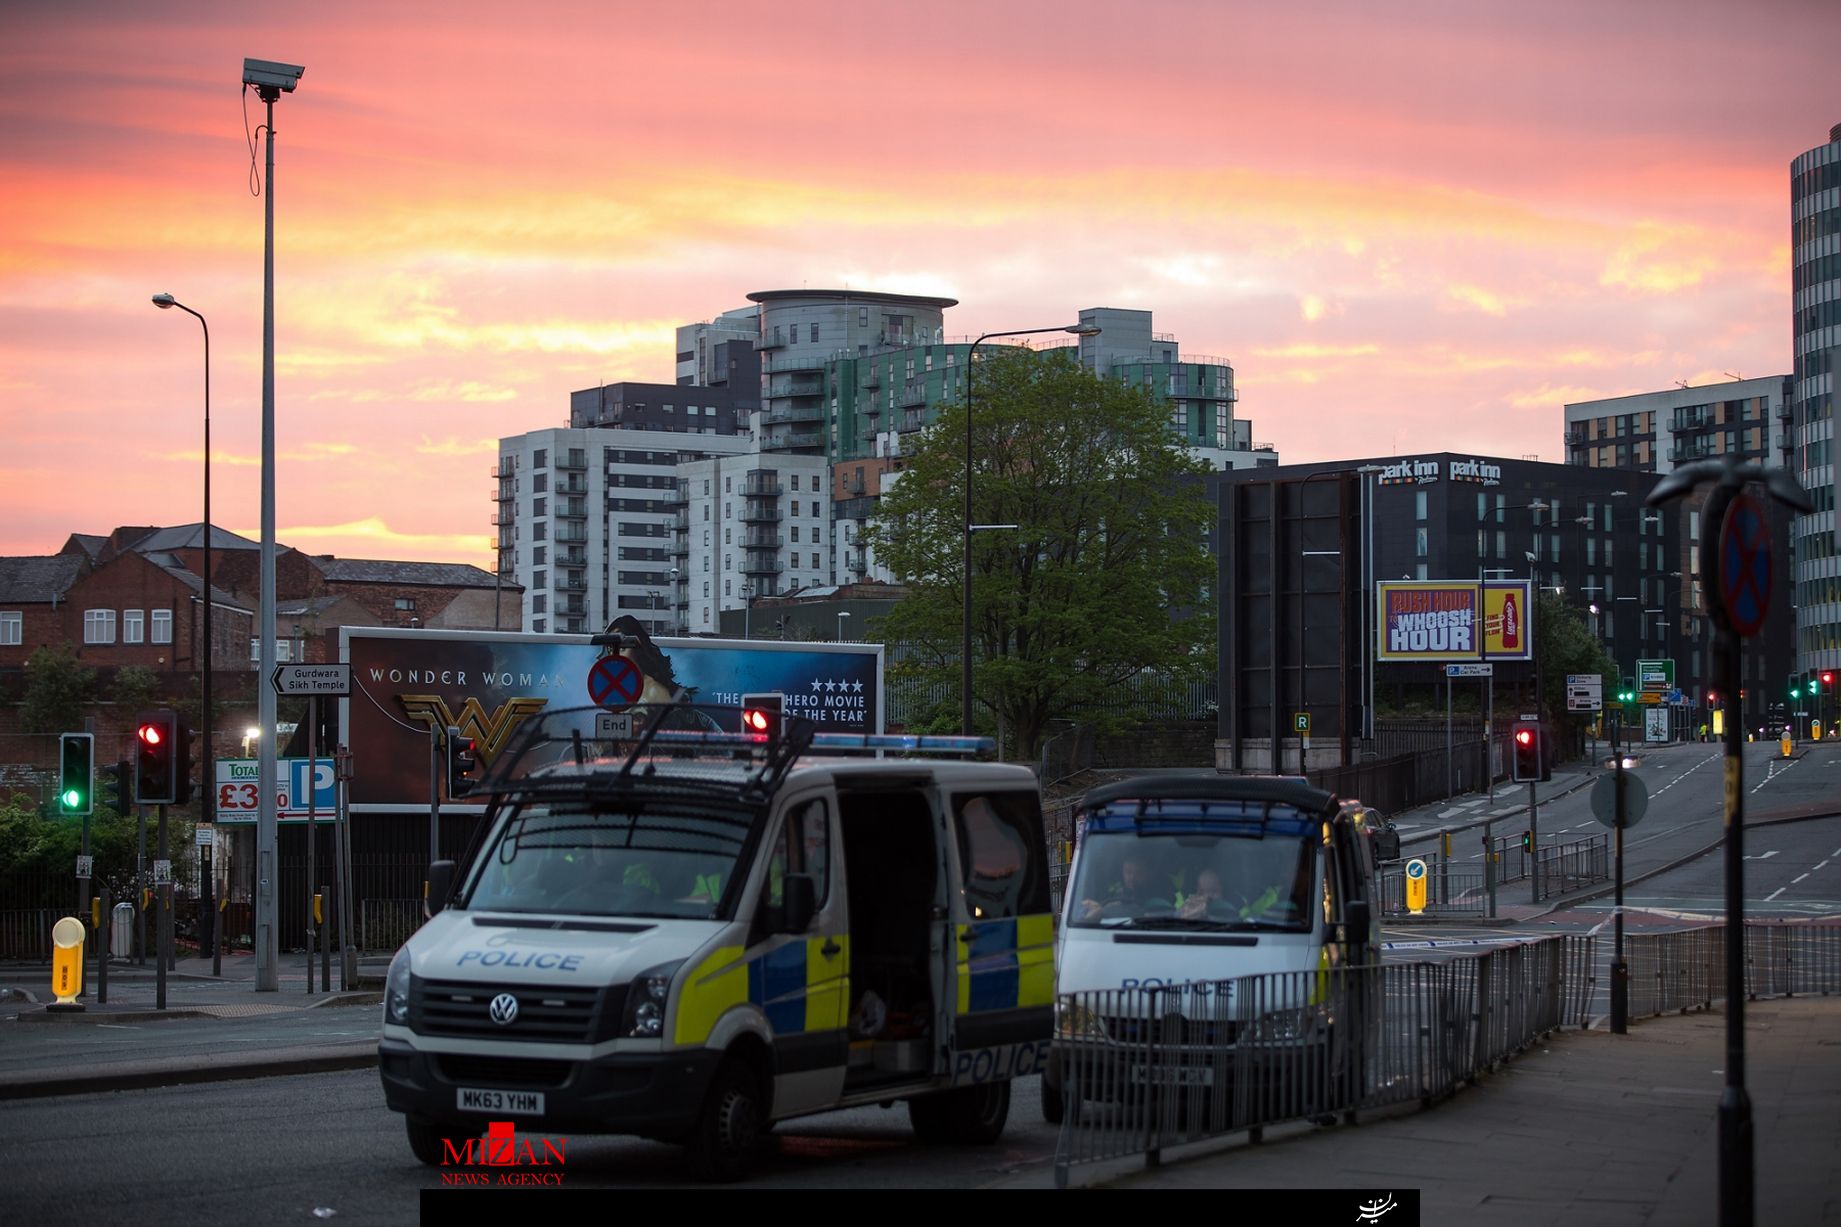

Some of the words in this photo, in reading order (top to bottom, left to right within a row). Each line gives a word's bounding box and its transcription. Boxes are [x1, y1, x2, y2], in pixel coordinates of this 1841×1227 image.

[1378, 460, 1413, 485] park
[1413, 460, 1439, 476] inn
[1450, 459, 1480, 481] park
[1480, 460, 1501, 479] inn
[1391, 591, 1431, 613] RUSH
[1433, 591, 1470, 612] HOUR
[1397, 608, 1471, 632] WHOOSH
[1391, 626, 1471, 651] HOUR
[294, 669, 339, 678] Gurdwara
[370, 668, 467, 686] WONDER
[482, 671, 566, 688] WOMAN
[289, 680, 309, 689] Sikh
[312, 680, 345, 690] Temple
[825, 695, 865, 708] MOVIE
[602, 718, 627, 730] End
[804, 709, 826, 721] THE
[1298, 716, 1307, 728] R
[301, 764, 335, 805] P
[456, 950, 585, 972] POLICE
[1120, 977, 1235, 998] POLICE
[952, 1040, 1050, 1087] POLICE
[463, 1090, 503, 1110] MK63
[506, 1093, 538, 1112] YHM
